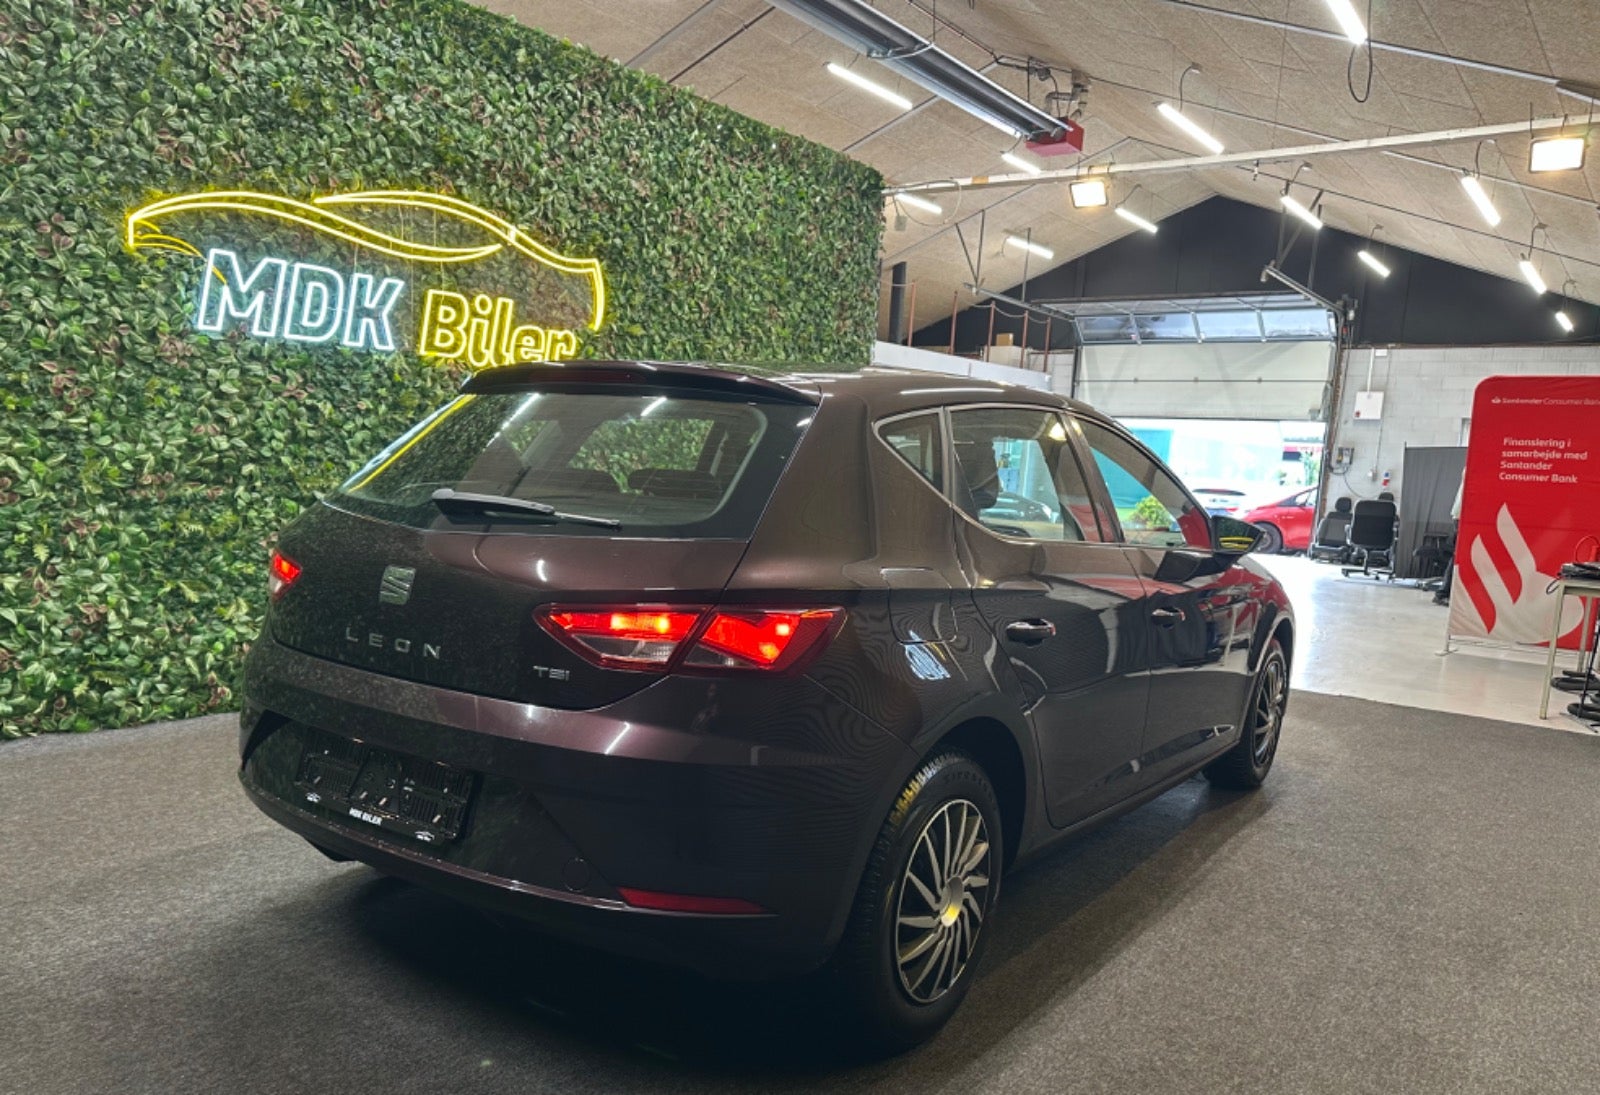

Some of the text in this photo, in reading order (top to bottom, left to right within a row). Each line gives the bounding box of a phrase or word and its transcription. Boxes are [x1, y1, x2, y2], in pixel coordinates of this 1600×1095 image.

[198, 248, 577, 367] MDK Biler
[1542, 397, 1582, 406] Consumer
[1503, 437, 1565, 449] Finansiering
[1501, 449, 1588, 461] samarbejde med
[1500, 460, 1553, 471] Santander
[1499, 471, 1578, 484] Consumer Bank
[345, 626, 442, 660] LEON
[533, 665, 570, 681] TSI
